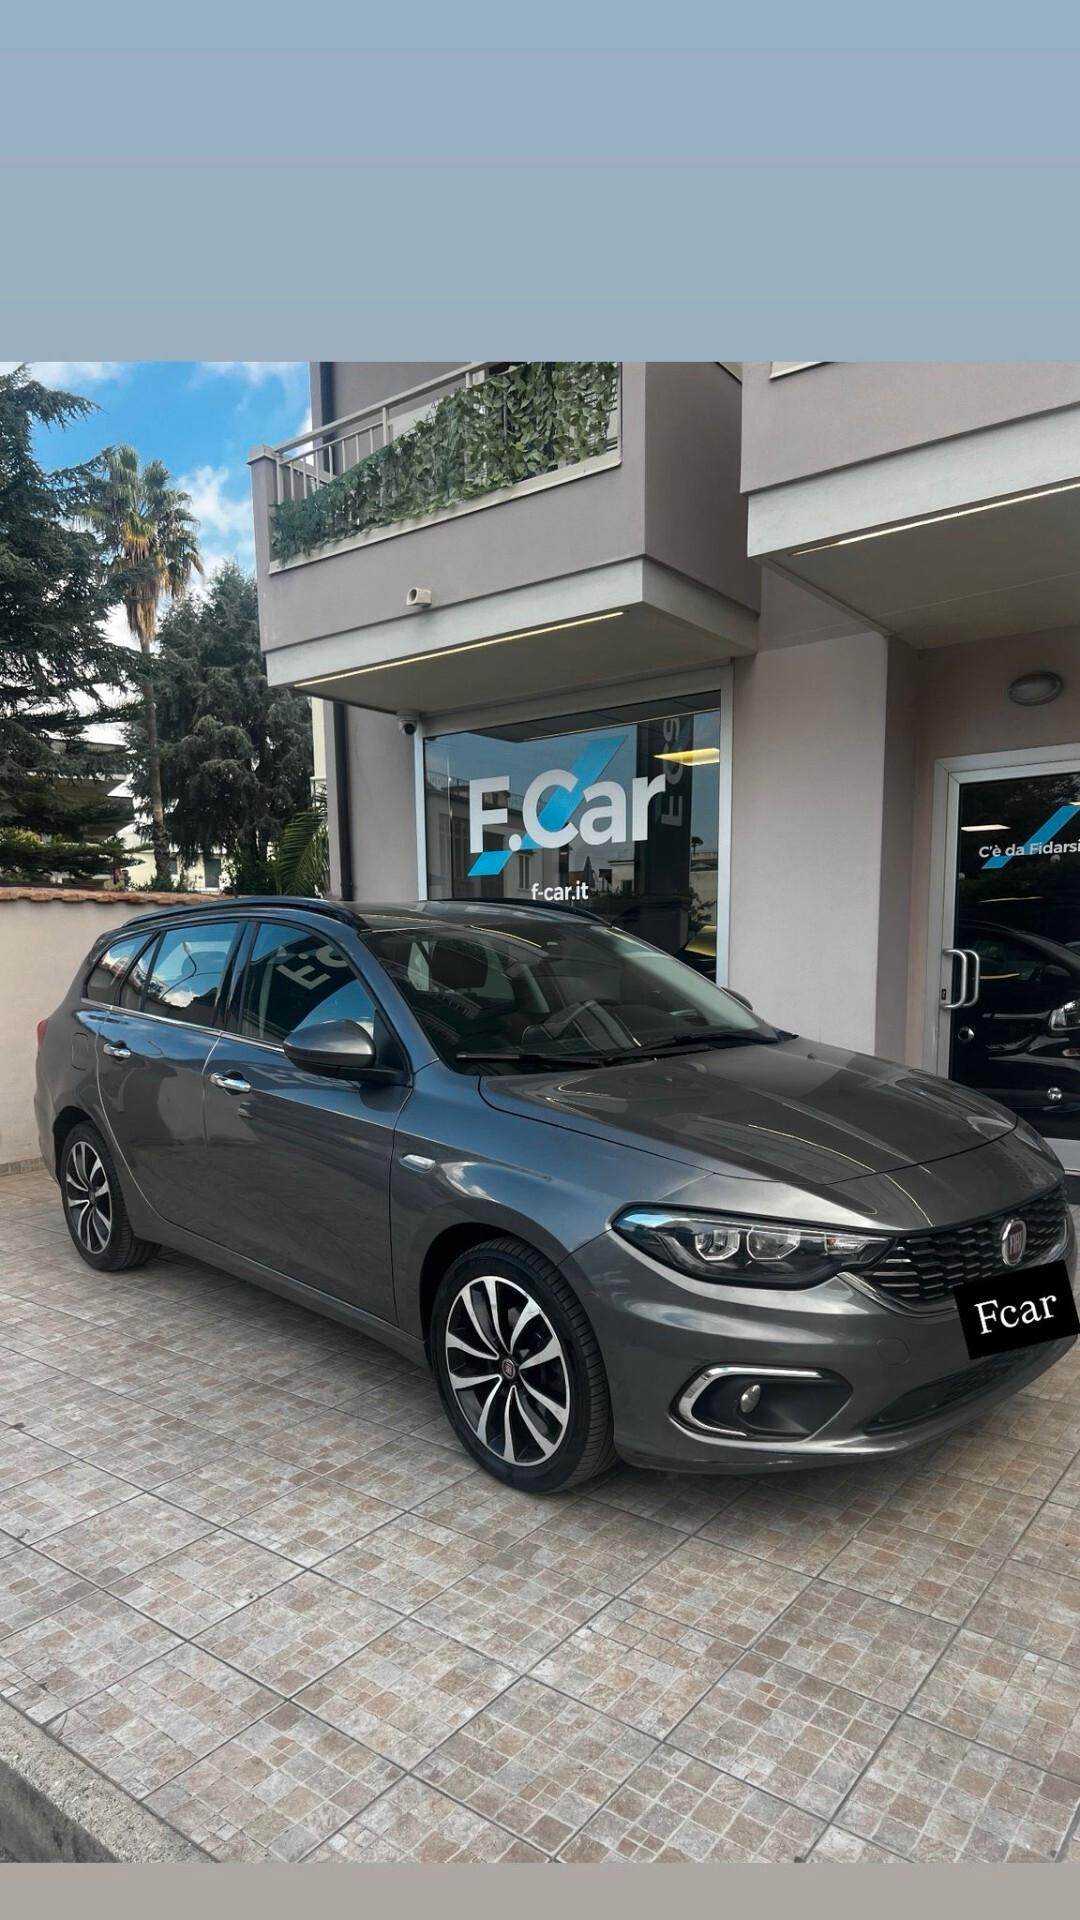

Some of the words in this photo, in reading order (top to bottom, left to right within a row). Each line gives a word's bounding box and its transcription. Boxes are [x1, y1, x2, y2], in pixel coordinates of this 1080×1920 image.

[468, 768, 666, 854] F.Car
[978, 844, 1002, 859] C'è
[1005, 843, 1025, 857] da
[1029, 839, 1080, 855] Fidarsi
[530, 880, 589, 901] f-car.it
